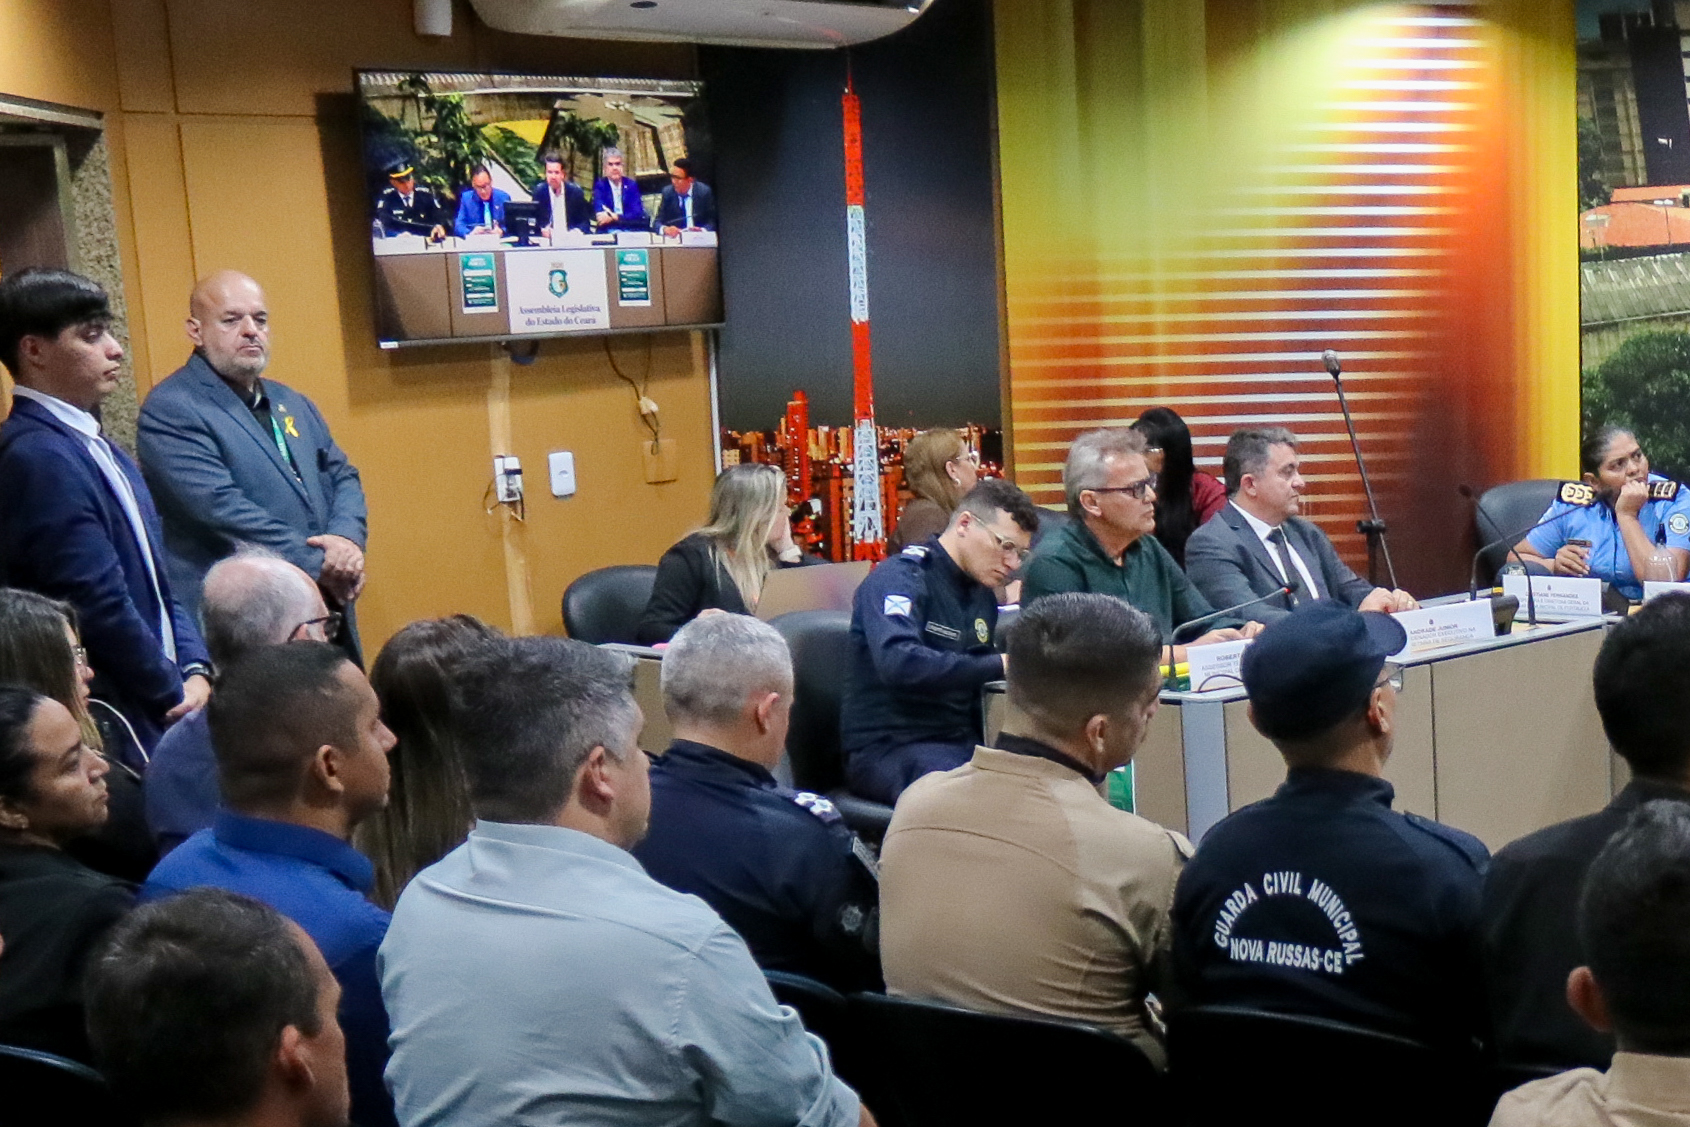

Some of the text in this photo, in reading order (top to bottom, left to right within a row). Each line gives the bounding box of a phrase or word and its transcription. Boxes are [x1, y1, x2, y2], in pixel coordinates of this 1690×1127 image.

[1216, 652, 1240, 661] ROBERT
[1214, 871, 1365, 965] GUARDA CIVIL MUNICIPAL
[1229, 937, 1343, 974] NOVA RUSSAS-CE
